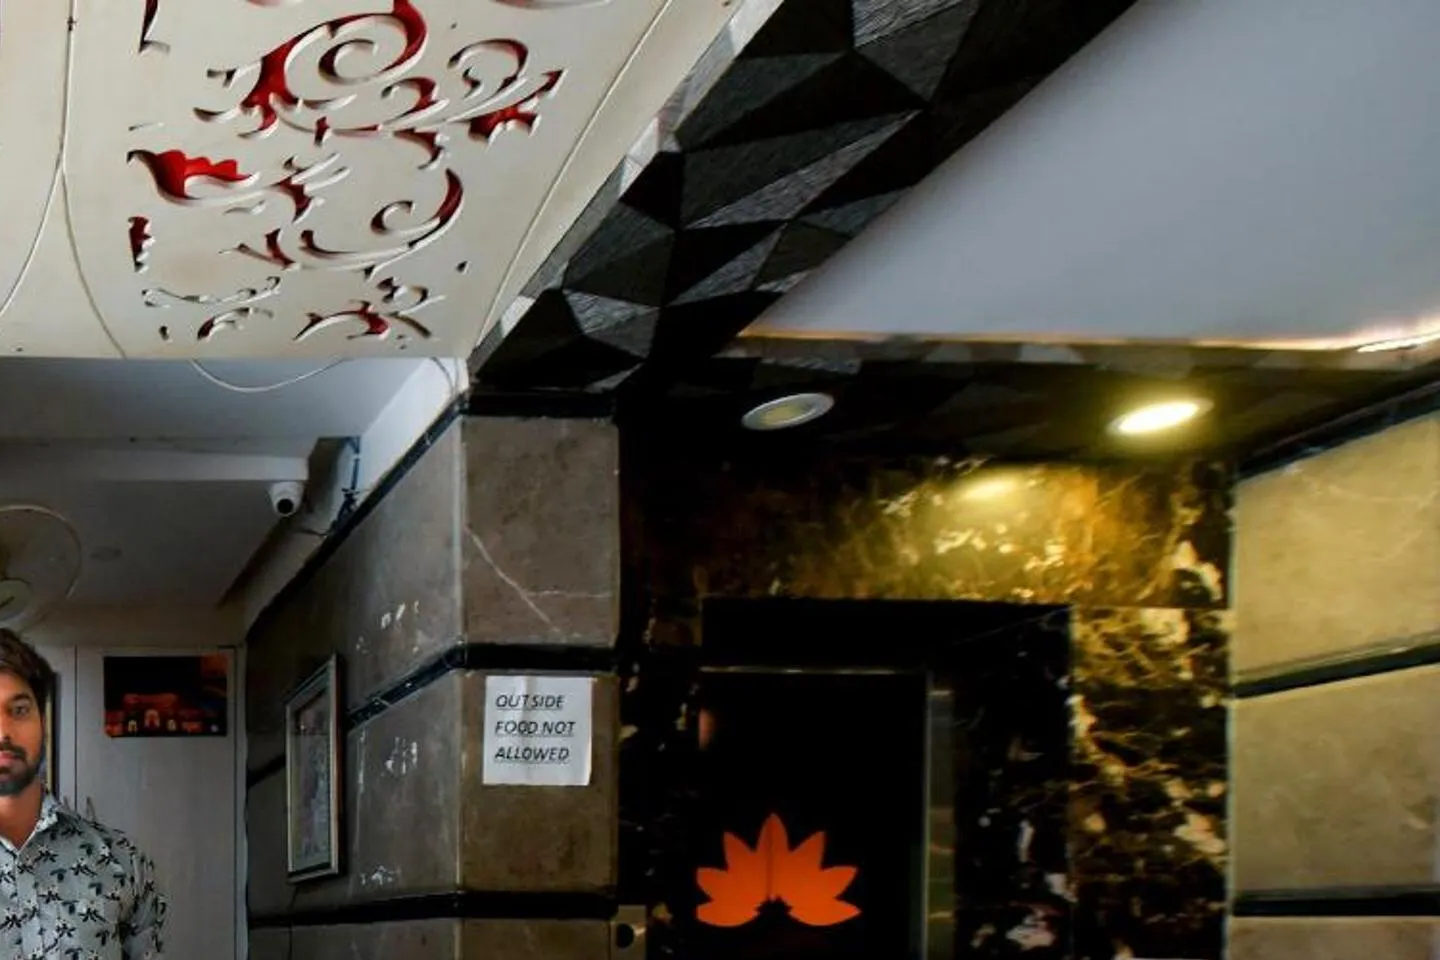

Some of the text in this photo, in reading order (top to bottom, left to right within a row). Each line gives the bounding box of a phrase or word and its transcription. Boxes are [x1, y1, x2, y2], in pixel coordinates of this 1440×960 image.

[495, 694, 565, 709] OUTSIDE
[495, 721, 576, 735] FOOD NOT
[495, 747, 570, 761] ALLOWED
